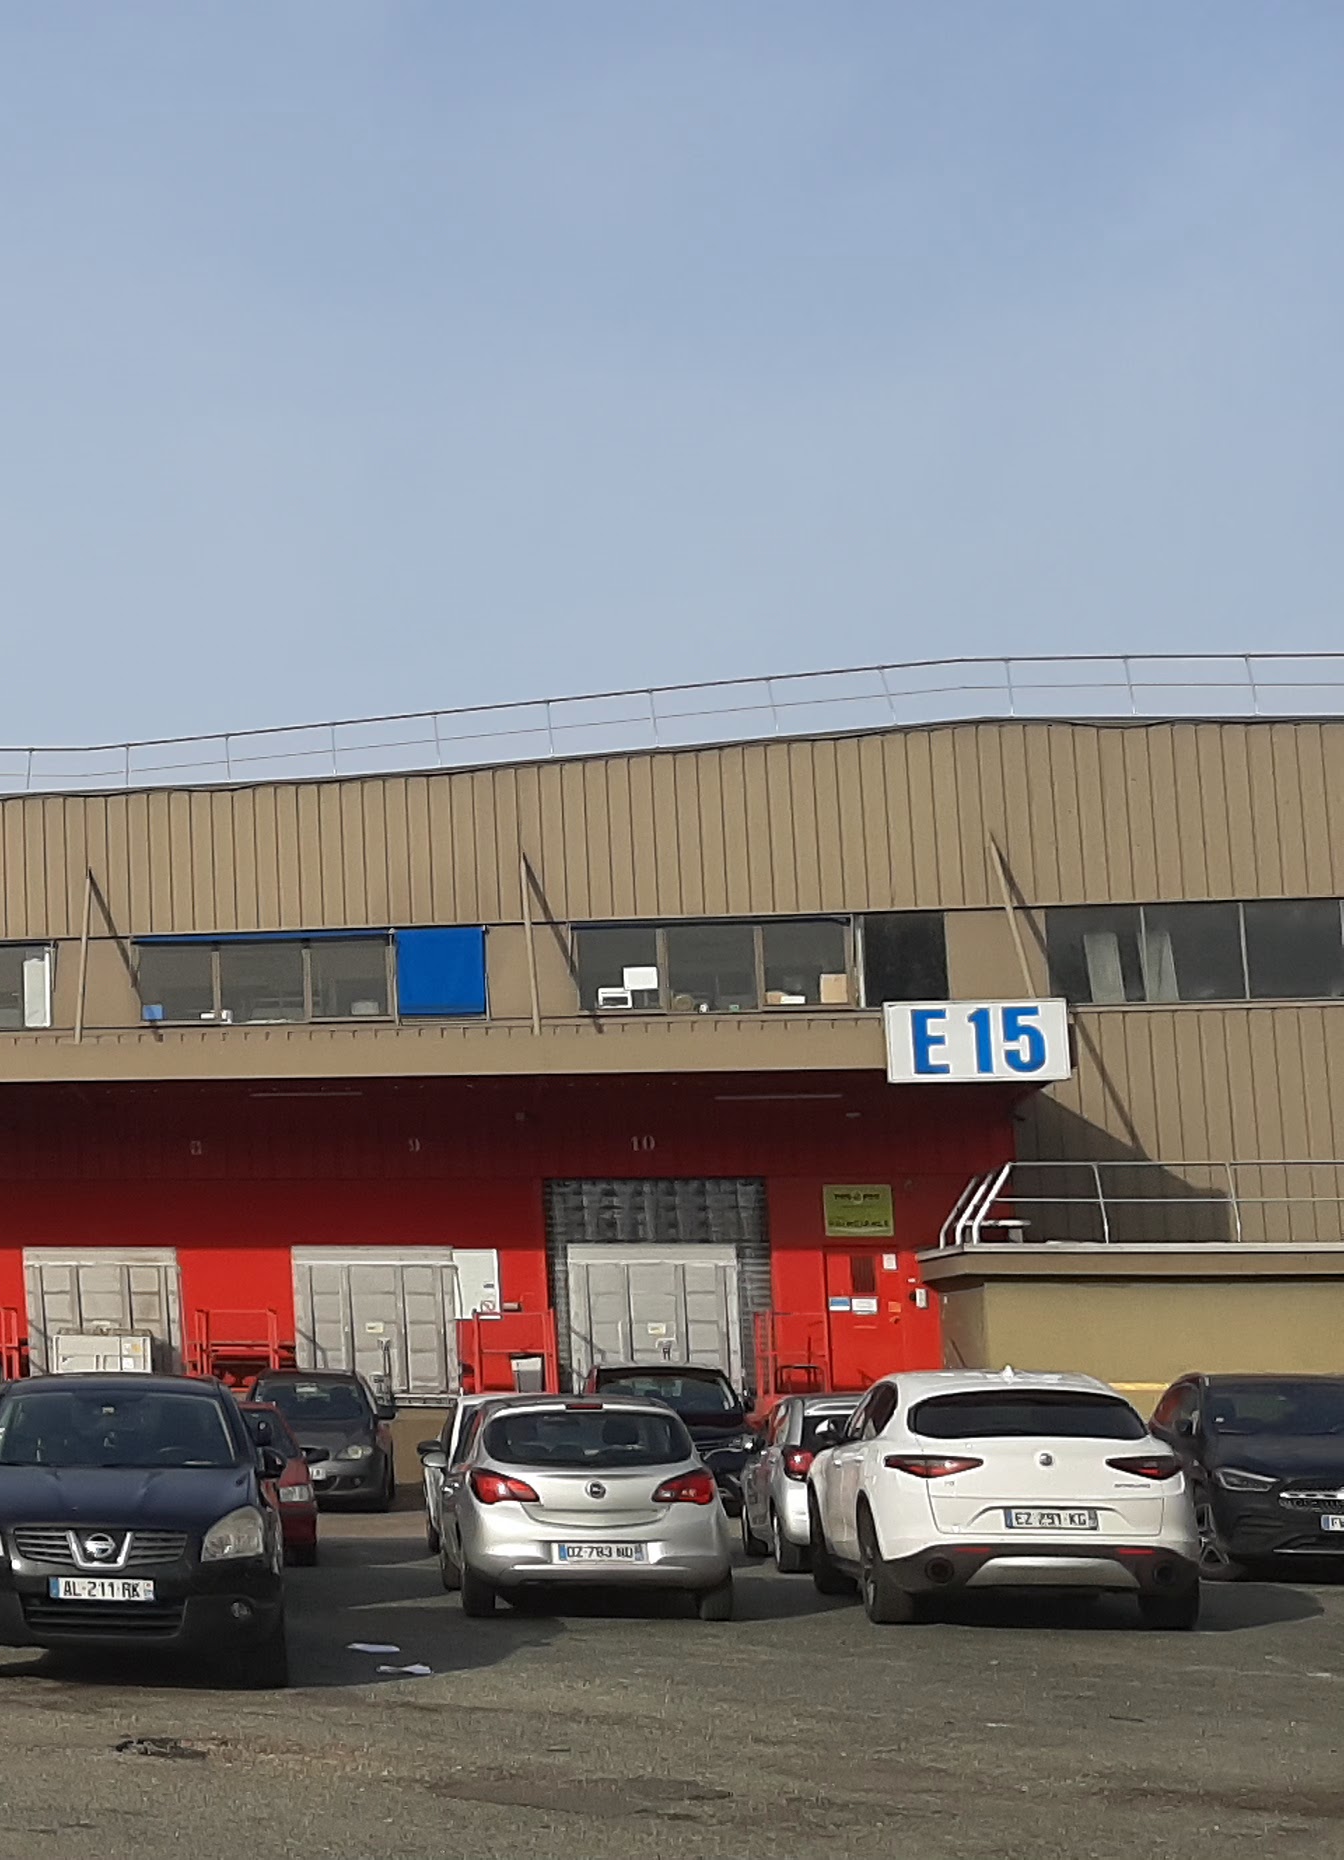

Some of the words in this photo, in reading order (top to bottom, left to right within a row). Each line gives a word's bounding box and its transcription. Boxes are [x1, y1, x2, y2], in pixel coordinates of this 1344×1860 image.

[910, 1009, 950, 1074] E
[967, 1006, 1046, 1074] 15
[630, 1135, 656, 1152] 10
